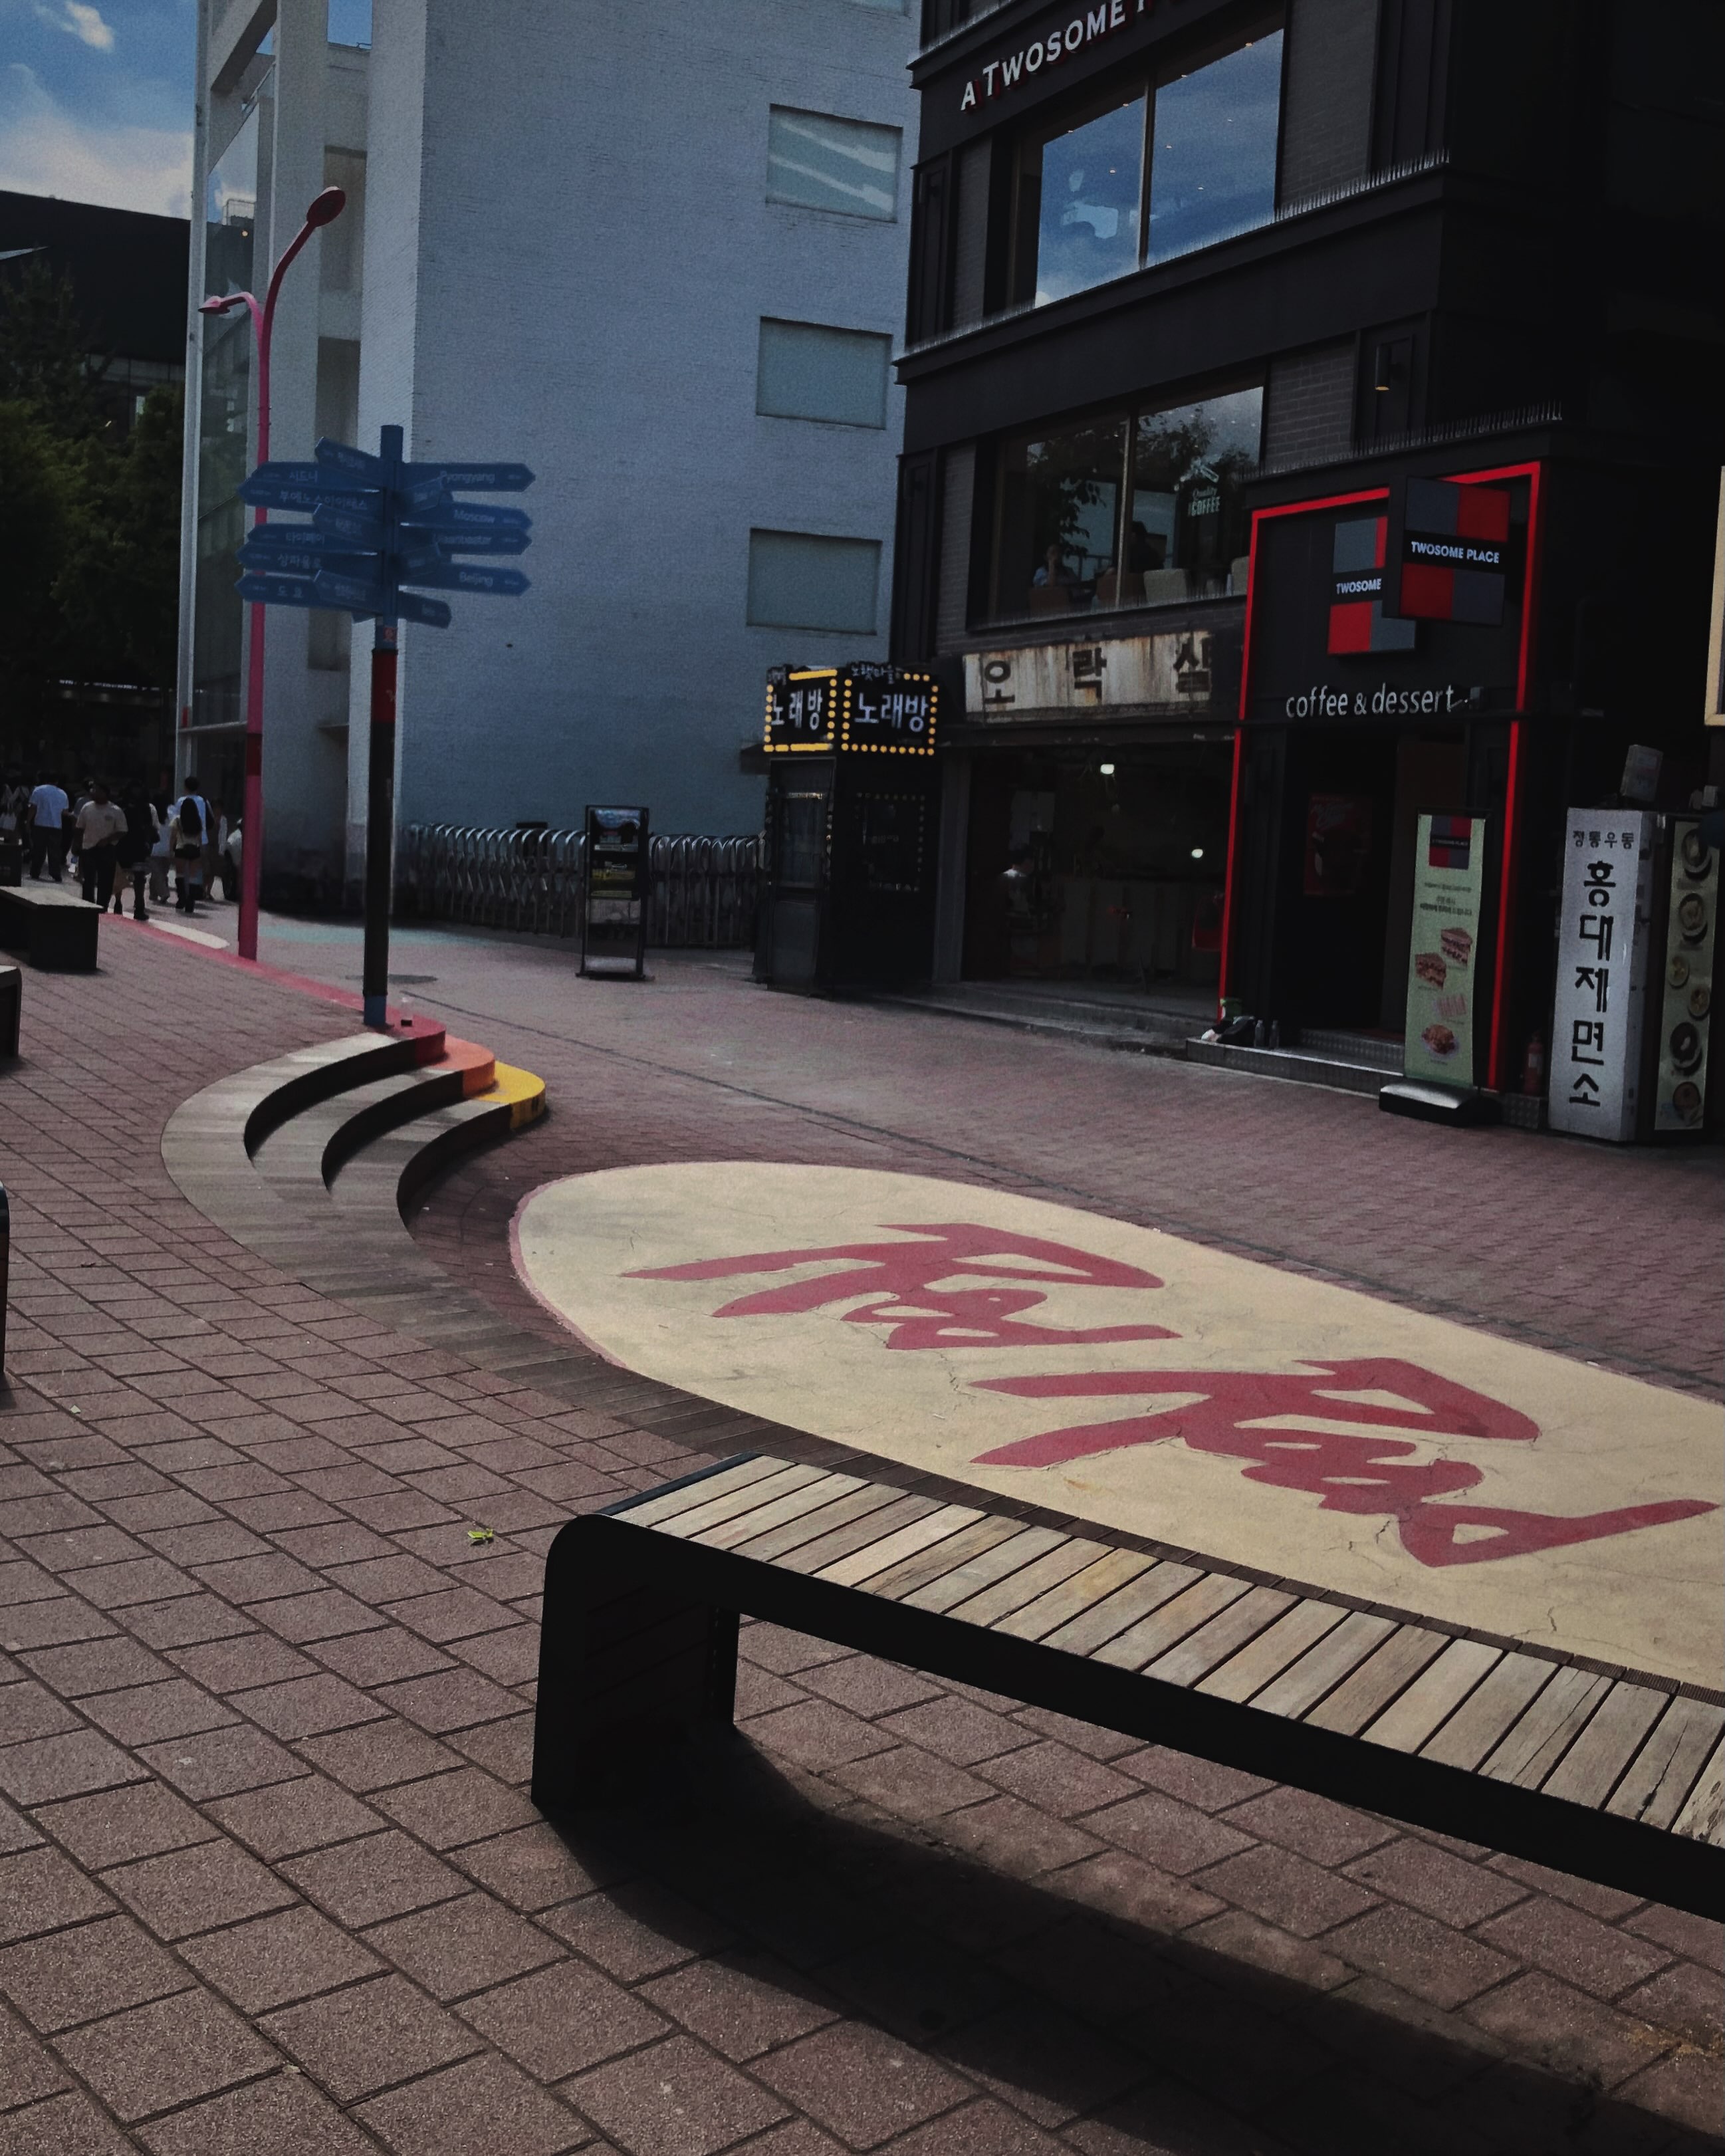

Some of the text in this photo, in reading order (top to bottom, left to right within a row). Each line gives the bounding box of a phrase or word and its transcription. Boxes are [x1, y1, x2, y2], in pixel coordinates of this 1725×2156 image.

[961, 0, 1127, 111] A TWOSOME
[453, 509, 496, 524] Moscow
[1191, 496, 1221, 517] COFFEE
[1411, 540, 1500, 564] TWOSOME PLACE
[459, 571, 494, 588] Beijing
[1336, 578, 1382, 595] TWOSOME
[983, 633, 1213, 706] 오락실
[770, 687, 824, 731] 노래방
[854, 692, 929, 733] 노래방
[1286, 682, 1454, 719] coffee & dessert
[1573, 830, 1635, 850] 정통우동
[1568, 860, 1617, 1108] 홍대제면소
